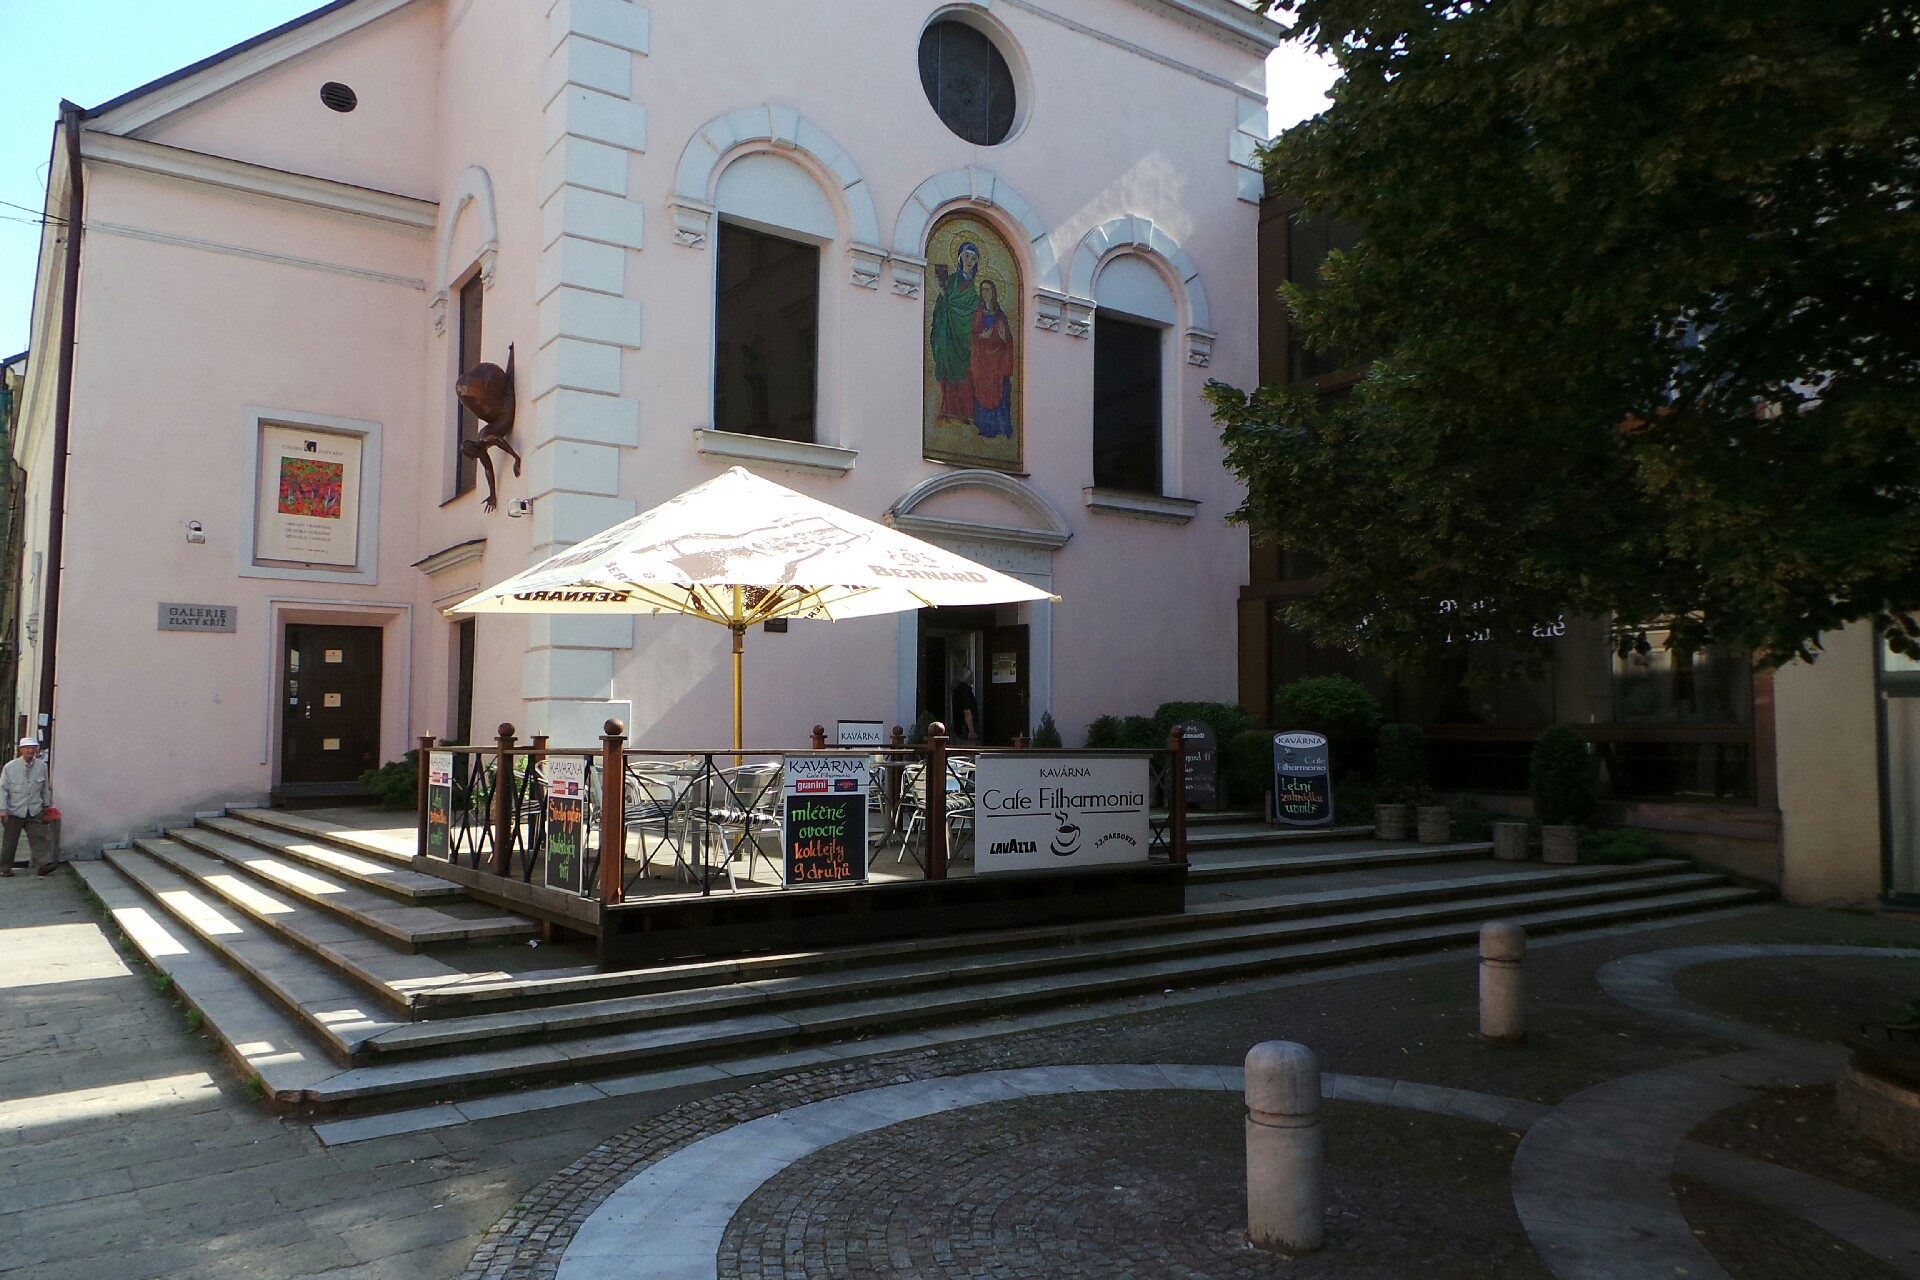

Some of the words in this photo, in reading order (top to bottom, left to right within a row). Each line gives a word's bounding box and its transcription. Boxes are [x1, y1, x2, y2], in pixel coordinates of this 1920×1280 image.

[867, 564, 988, 583] BERNARD
[169, 607, 227, 618] GALERIE
[169, 617, 199, 626] ZLATÝ
[841, 730, 880, 741] KAVÁRNA
[1278, 735, 1322, 744] KAVÁRNA
[789, 757, 866, 774] KAVÁRNA
[1039, 765, 1091, 778] KAVÁRNA
[797, 780, 827, 792] granini
[1281, 777, 1313, 793] Letní
[982, 788, 1032, 810] Cafe
[1039, 787, 1144, 809] Filharmonia
[791, 801, 848, 822] mléčné
[799, 820, 847, 839] ovocné
[794, 838, 844, 863] koktejly
[989, 838, 1037, 855] LAVAZZA
[794, 862, 805, 881] 9
[807, 860, 851, 880] druhů
